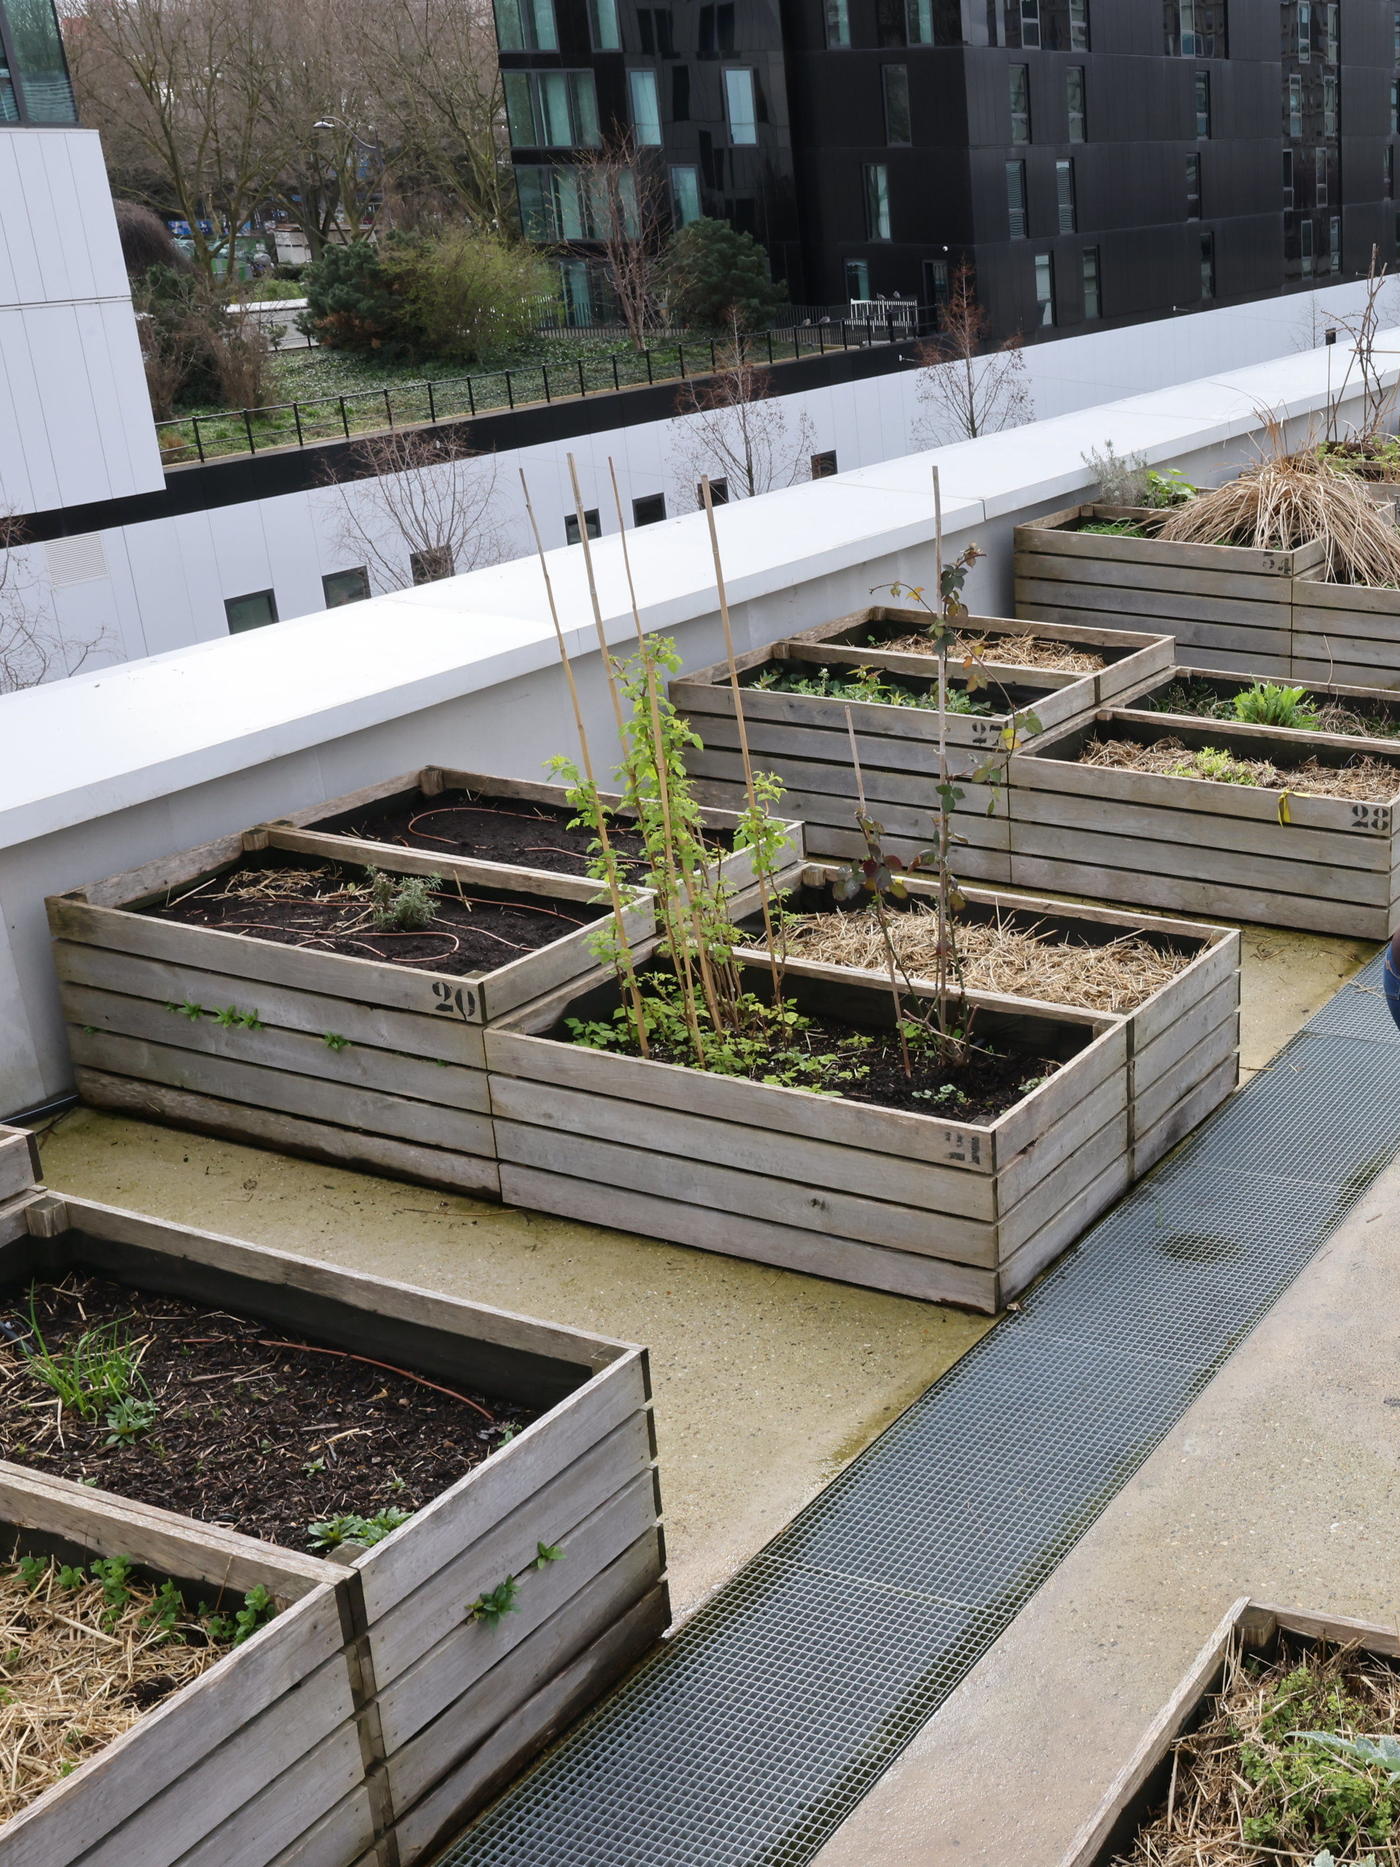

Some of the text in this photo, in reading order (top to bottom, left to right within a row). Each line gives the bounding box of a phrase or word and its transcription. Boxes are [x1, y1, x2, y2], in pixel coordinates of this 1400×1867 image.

[1351, 804, 1389, 831] 28
[432, 982, 475, 1021] 20
[944, 1131, 981, 1165] 21
